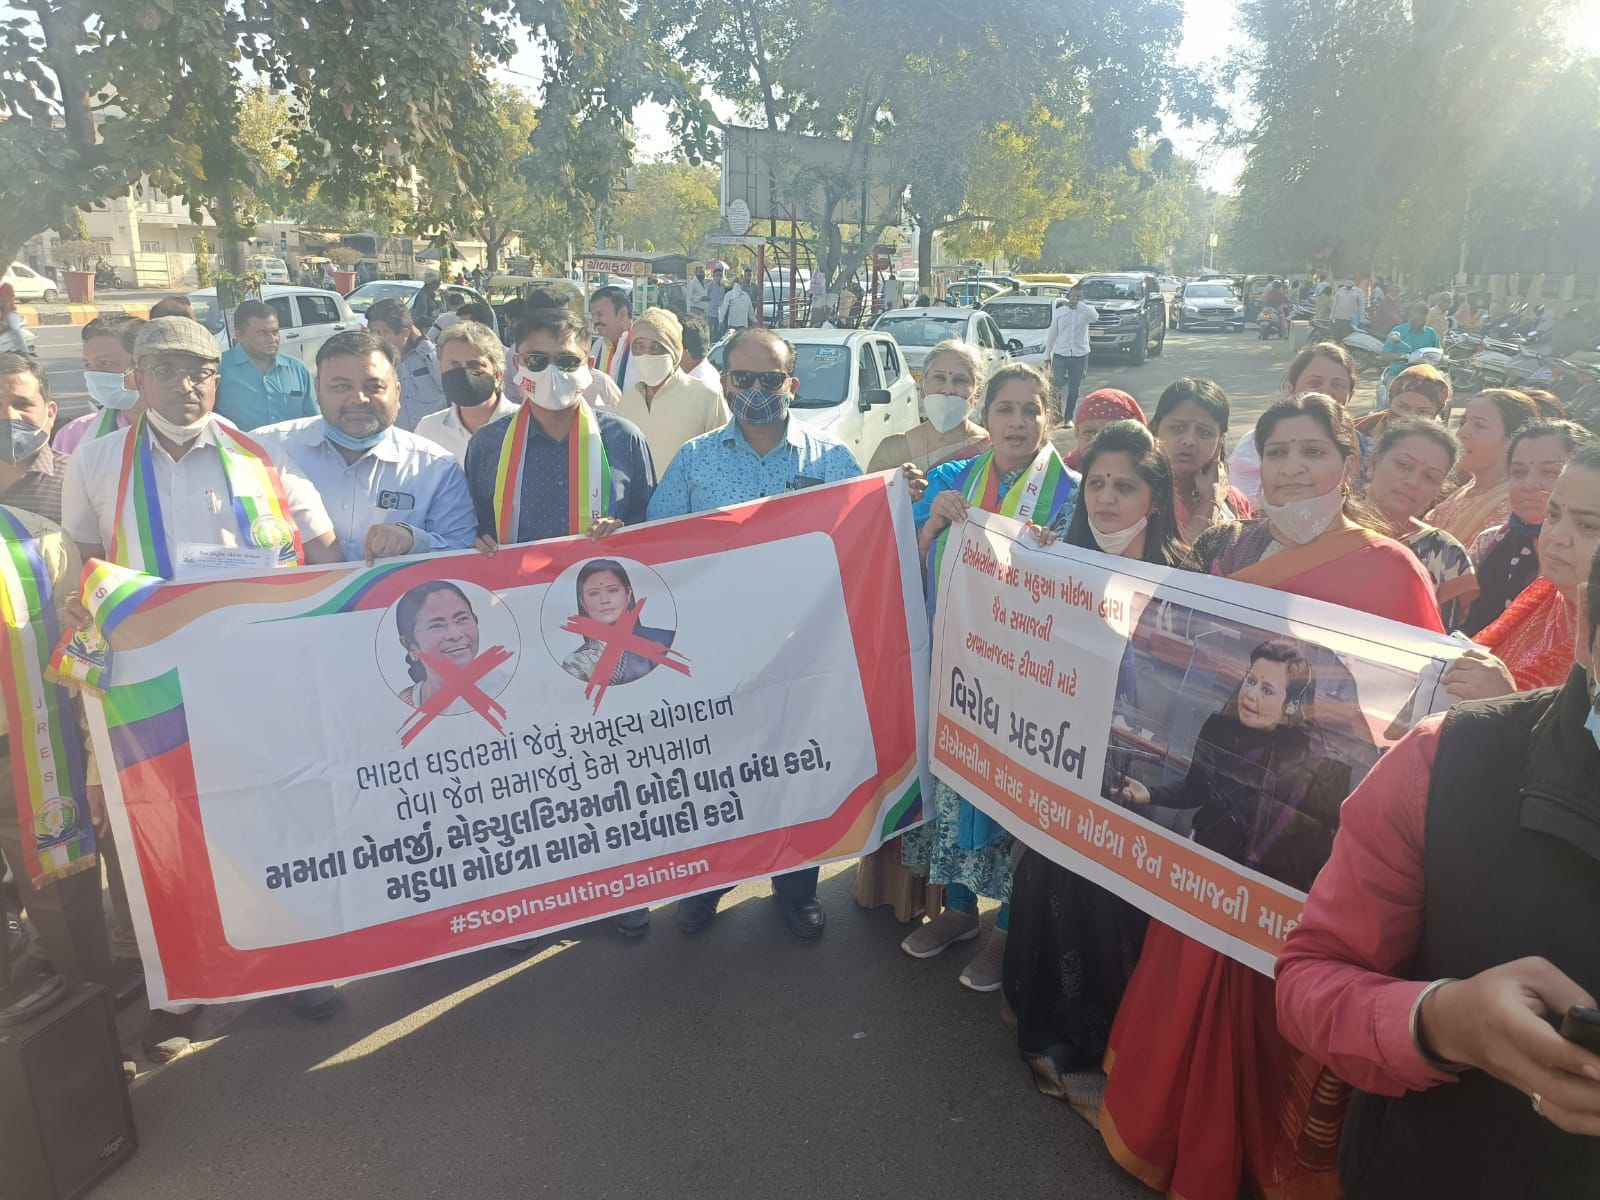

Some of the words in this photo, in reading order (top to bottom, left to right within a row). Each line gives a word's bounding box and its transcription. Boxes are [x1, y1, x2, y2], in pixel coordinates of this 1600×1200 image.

[992, 596, 1006, 625] જૈન
[1010, 613, 1053, 642] સમાજની
[1024, 571, 1055, 603] મહુઆ
[1060, 576, 1092, 611] મોઈત્રા
[1098, 598, 1124, 621] દ્વારા
[1058, 668, 1077, 697] માટે
[356, 757, 419, 790] ભારત
[426, 731, 518, 775] ઘડતરમાં
[523, 723, 566, 759] જેનું
[570, 712, 644, 747] અમૂલ્ય
[650, 694, 734, 729] યોગદાન
[950, 666, 1000, 735] વિરોધ
[1008, 711, 1087, 780] પ્રદર્શન
[265, 850, 347, 890] મમતા
[353, 821, 442, 870] બેનર્જી,
[446, 780, 632, 850] સેક્યુલરિઝમની
[636, 767, 690, 806] બોદી
[694, 765, 735, 793] વાત
[784, 738, 831, 774] કરો,
[397, 788, 437, 820] તેવા
[443, 777, 483, 809] જૈન
[491, 755, 581, 800] સમાજનું
[582, 750, 619, 780] કેમ
[626, 734, 712, 769] અપમાન
[545, 823, 600, 864] સામે
[605, 801, 699, 850] કાર્યવાહી
[703, 790, 744, 827] કરો
[939, 724, 991, 780] ટીએમસીના
[994, 765, 1025, 804] સાંસદ
[1029, 786, 1072, 830] મહુઆ
[1077, 809, 1125, 859] મોઈત્રા
[1131, 835, 1162, 879] જૈન
[1170, 863, 1249, 924] સમાજની
[450, 859, 710, 934] #StopInsultingJainism
